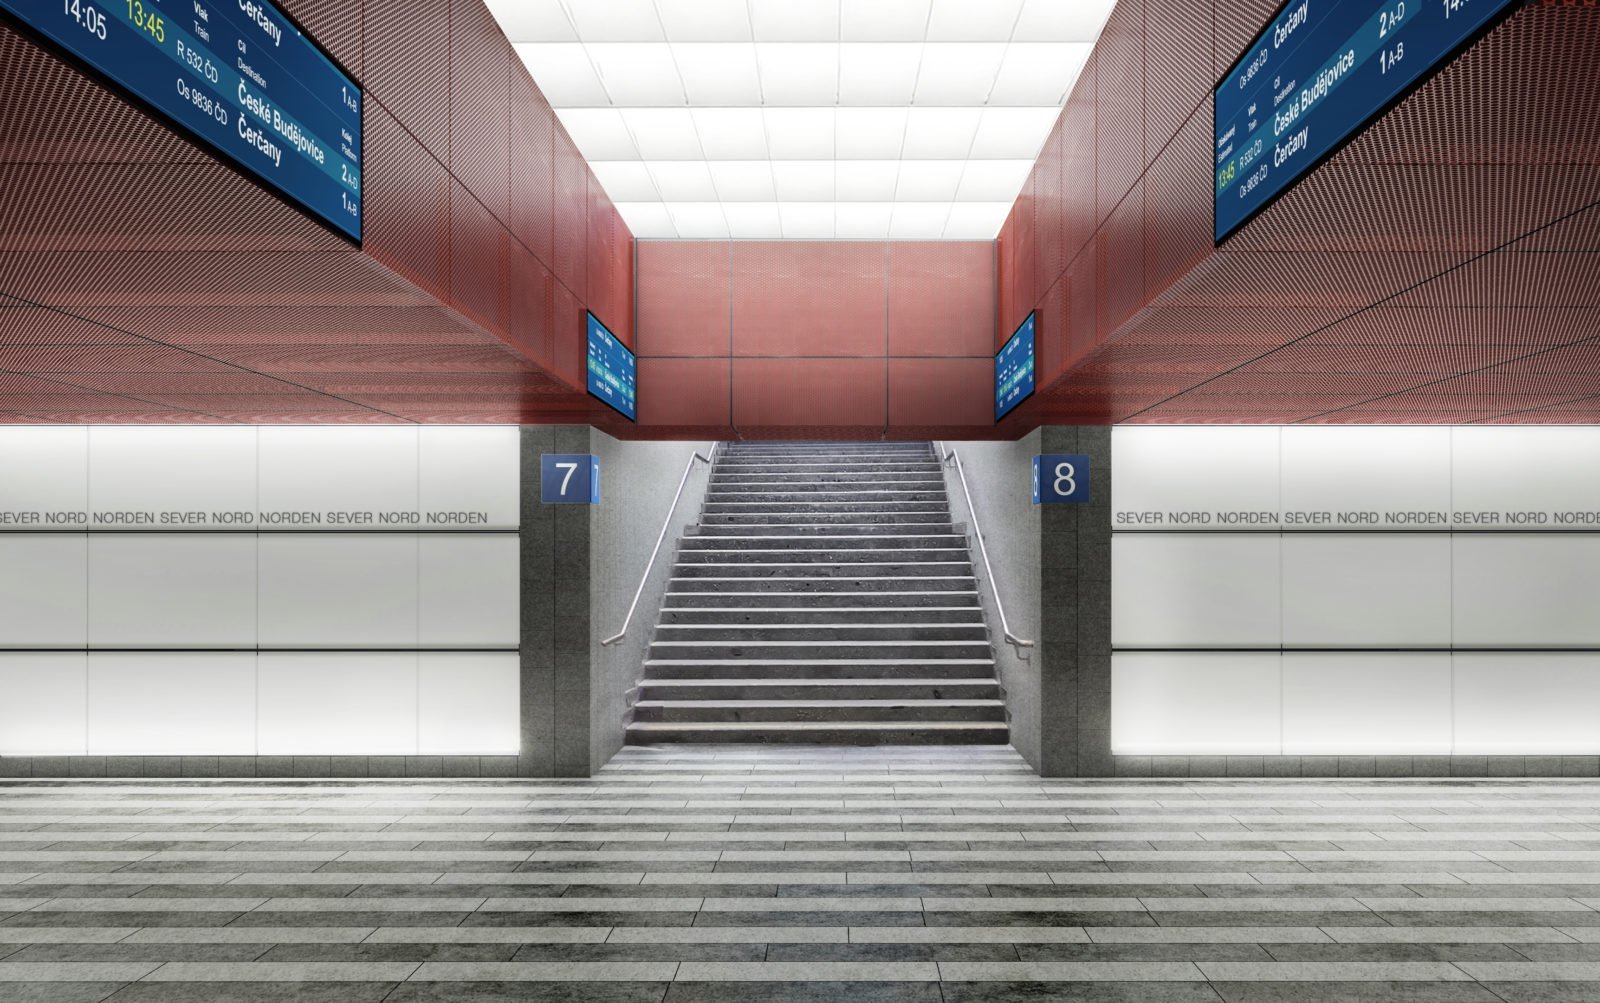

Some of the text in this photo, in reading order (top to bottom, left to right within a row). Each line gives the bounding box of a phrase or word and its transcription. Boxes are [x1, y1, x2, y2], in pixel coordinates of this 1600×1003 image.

[64, 0, 106, 40] 14:05
[126, 0, 165, 42] 13:45
[193, 0, 209, 22] Vlak
[1274, 0, 1308, 48] Čerčany
[1380, 2, 1405, 39] 2 A-D
[193, 20, 210, 42] Train
[177, 40, 218, 84] R 532 ČD
[238, 57, 267, 88] Destination
[1380, 42, 1404, 75] 1 A-B
[177, 78, 228, 125] Os 9836 ČD
[342, 86, 347, 104] 1
[1274, 96, 1300, 136] České
[1301, 49, 1354, 112] Budějovice
[238, 78, 324, 164] České Budějovice
[238, 112, 282, 168] Čerčany
[1274, 126, 1308, 168] Čerčany
[342, 164, 348, 182] 2
[1218, 160, 1235, 189] 13:45
[342, 192, 347, 210] 1
[555, 462, 578, 496] 7
[594, 464, 599, 496] 7
[1034, 464, 1038, 496] 8
[1054, 462, 1076, 496] 8
[0, 512, 488, 524] EVER NORD NORDEN SEVER NORD NORDEN SEVER NORD NORDEN
[1116, 512, 1163, 524] SEVER
[1169, 512, 1211, 524] NORD
[1217, 512, 1279, 524] NORDEN
[1284, 512, 1331, 524] SEVER
[1338, 512, 1379, 524] NORD
[1385, 512, 1447, 524] NORDEN
[1453, 512, 1500, 524] SEVER
[1506, 512, 1547, 524] NORD
